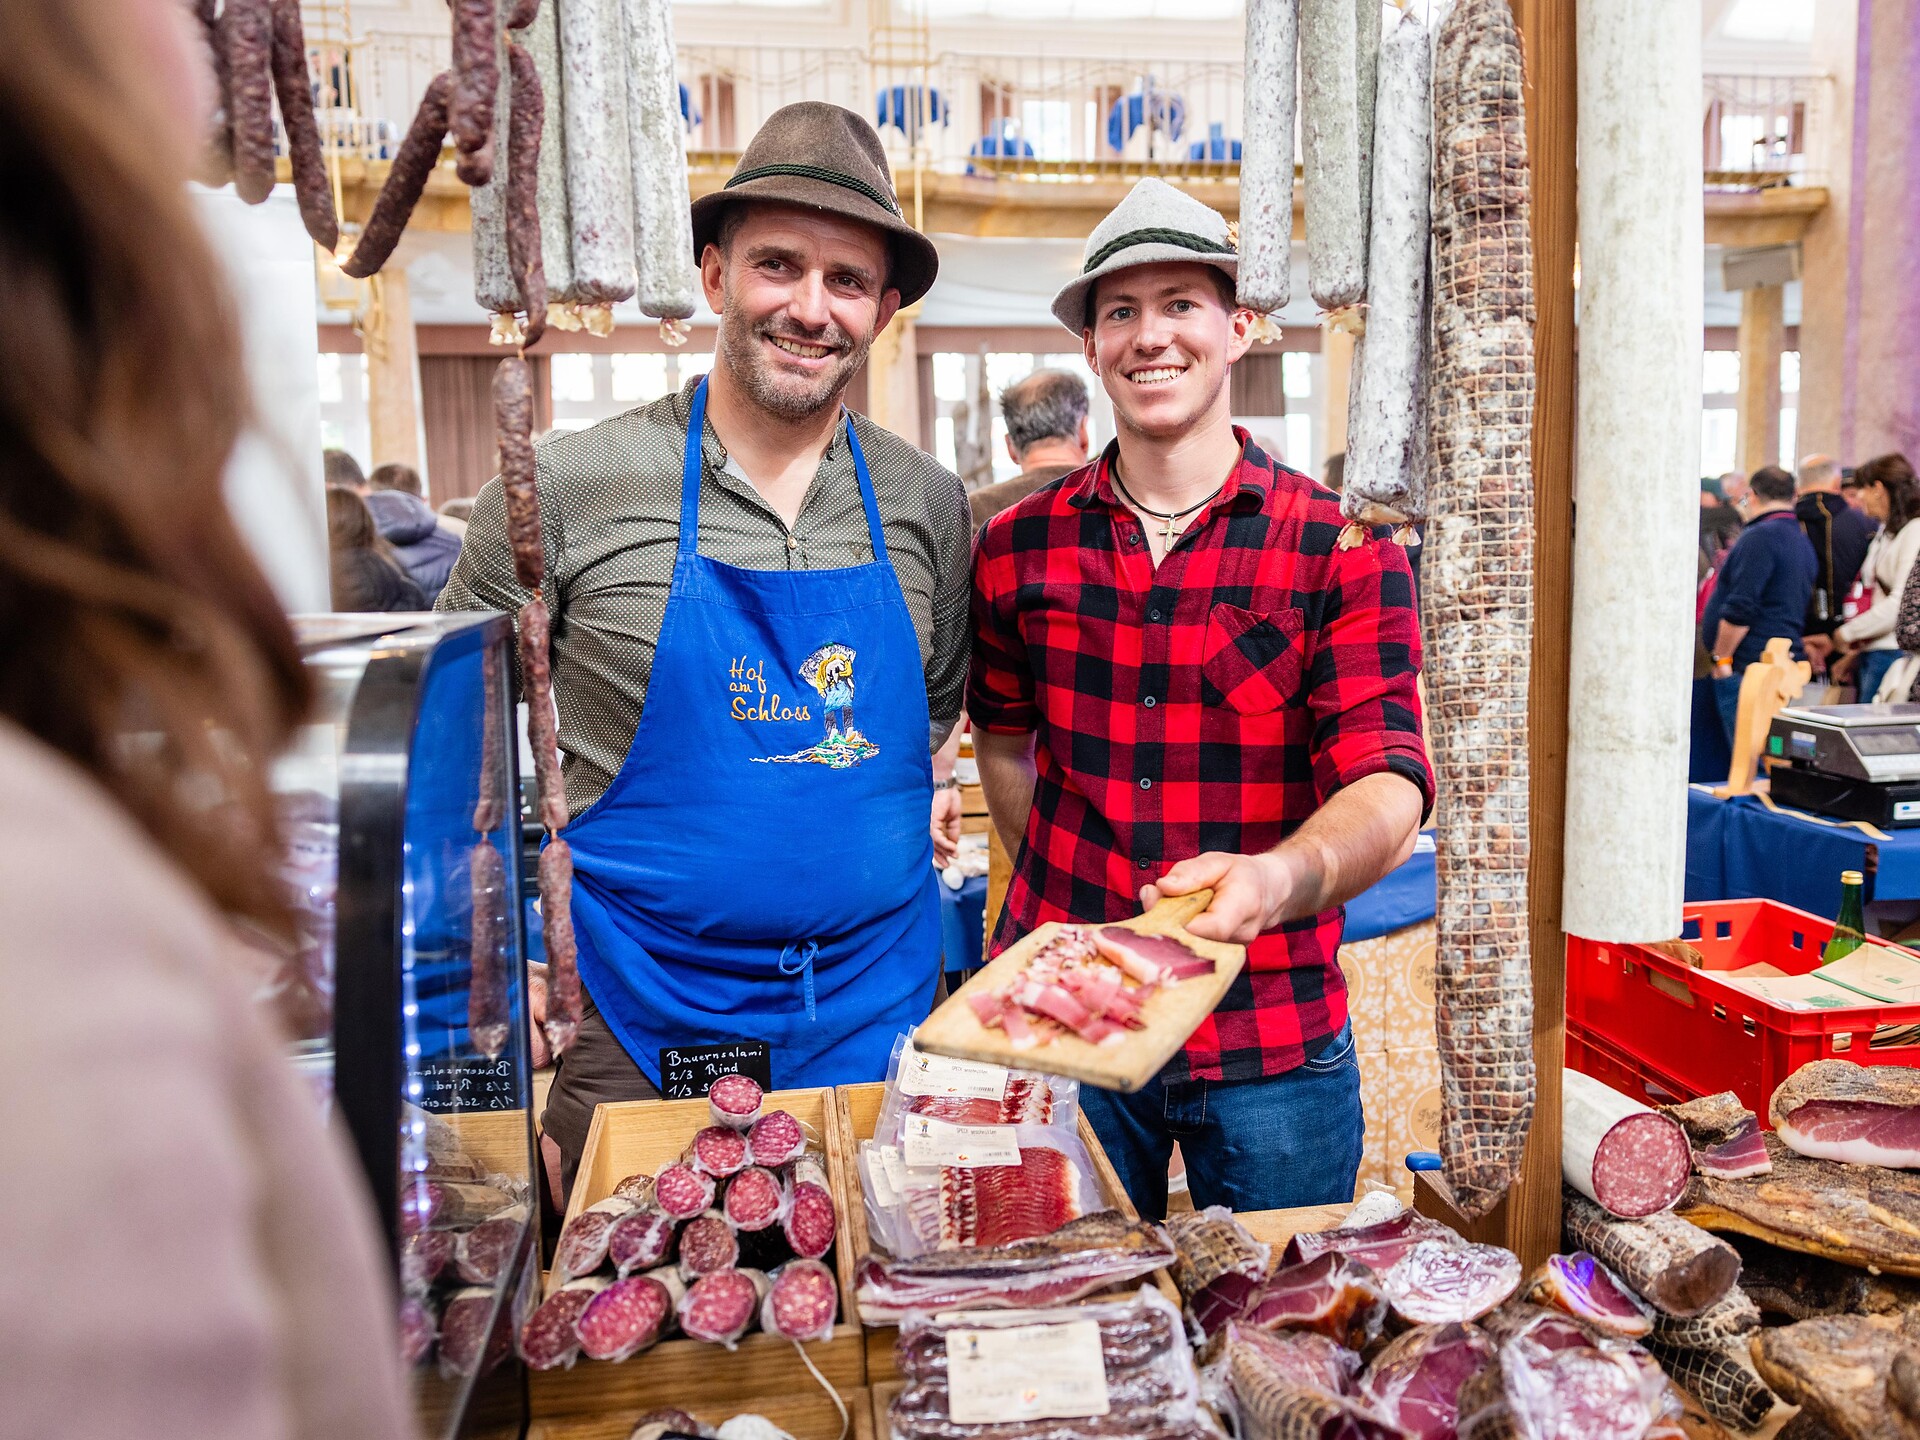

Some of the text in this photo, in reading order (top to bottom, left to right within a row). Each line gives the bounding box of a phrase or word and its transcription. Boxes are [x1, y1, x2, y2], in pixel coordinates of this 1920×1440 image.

[729, 655, 767, 694] Hof
[729, 682, 752, 693] am
[730, 694, 811, 721] Schloss
[666, 1045, 763, 1067] Bauernsalami
[669, 1062, 739, 1081] 2/3 Rind
[668, 1084, 692, 1098] 1/3
